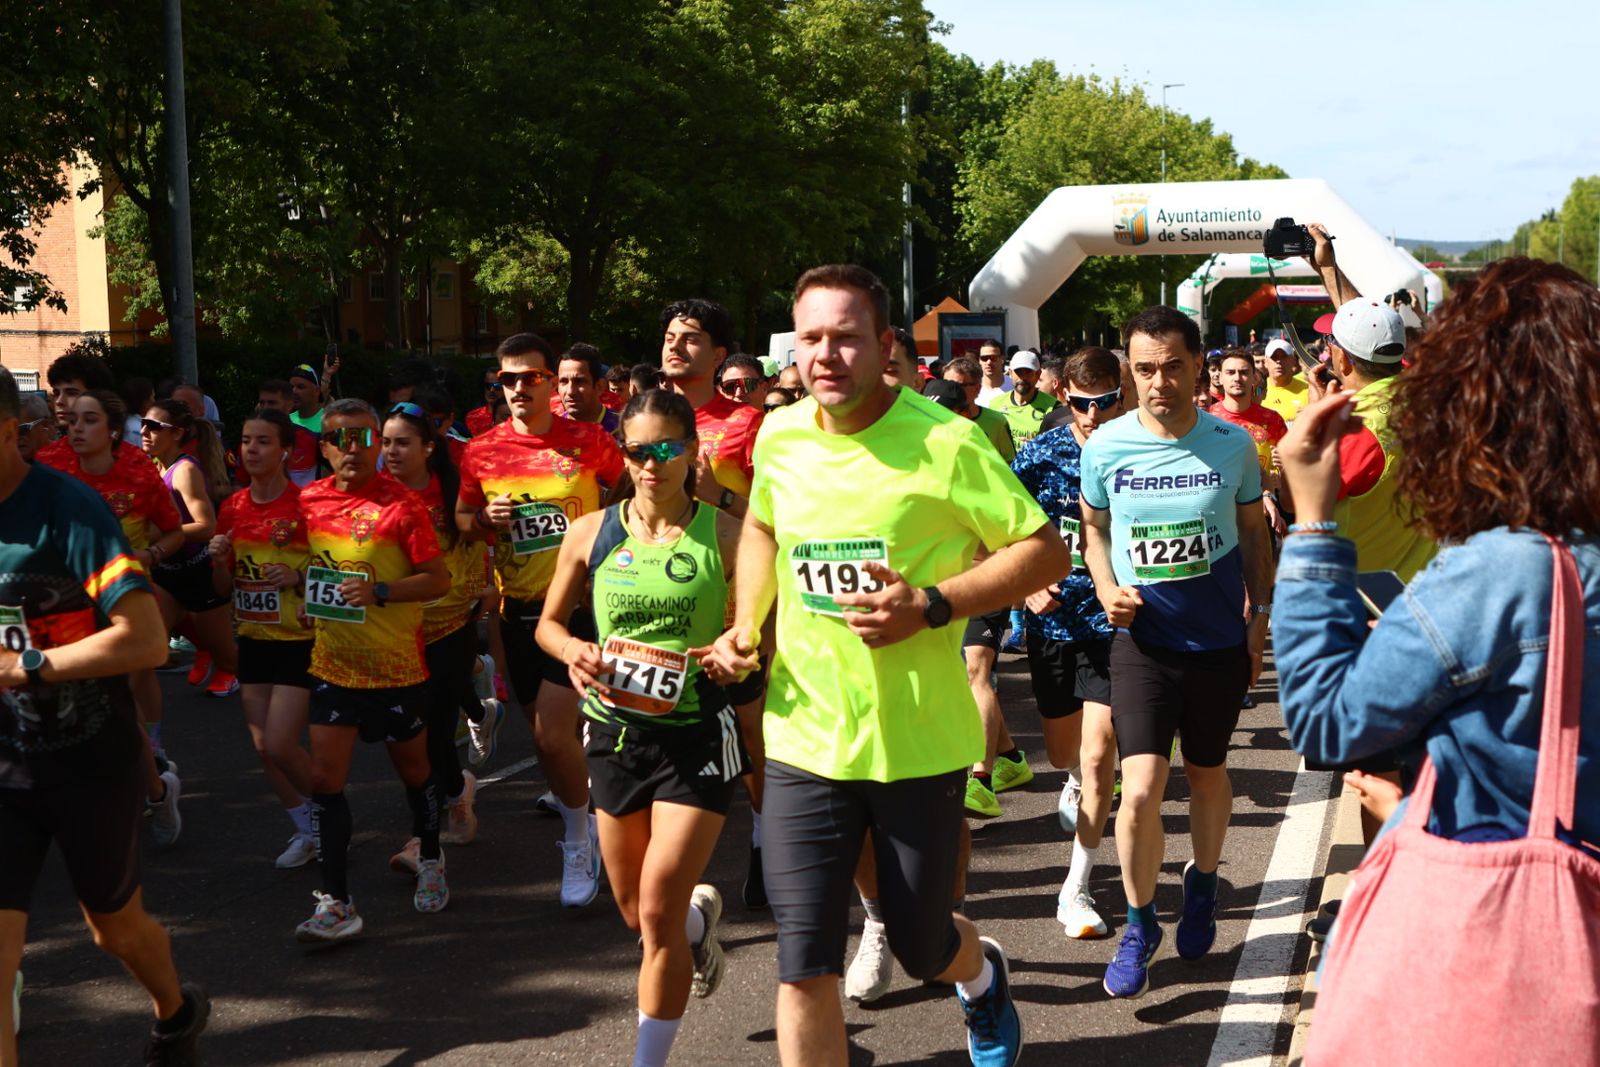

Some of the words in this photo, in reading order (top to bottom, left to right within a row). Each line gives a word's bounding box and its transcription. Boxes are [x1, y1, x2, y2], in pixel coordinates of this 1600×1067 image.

[1156, 208, 1262, 226] Ayuntamiento
[1158, 229, 1175, 242] de
[1181, 228, 1263, 241] Salamanca
[1114, 469, 1222, 493] FERREIRA
[512, 513, 567, 540] 1529
[1131, 526, 1148, 538] XIV
[793, 544, 811, 557] XIV
[1134, 535, 1206, 565] 1224
[797, 562, 884, 594] 1193
[236, 592, 277, 611] 1846
[606, 592, 697, 612] CORRECAMINOS
[608, 610, 691, 628] CARBAJOSA
[606, 641, 625, 654] XIV
[606, 657, 680, 699] 1715
